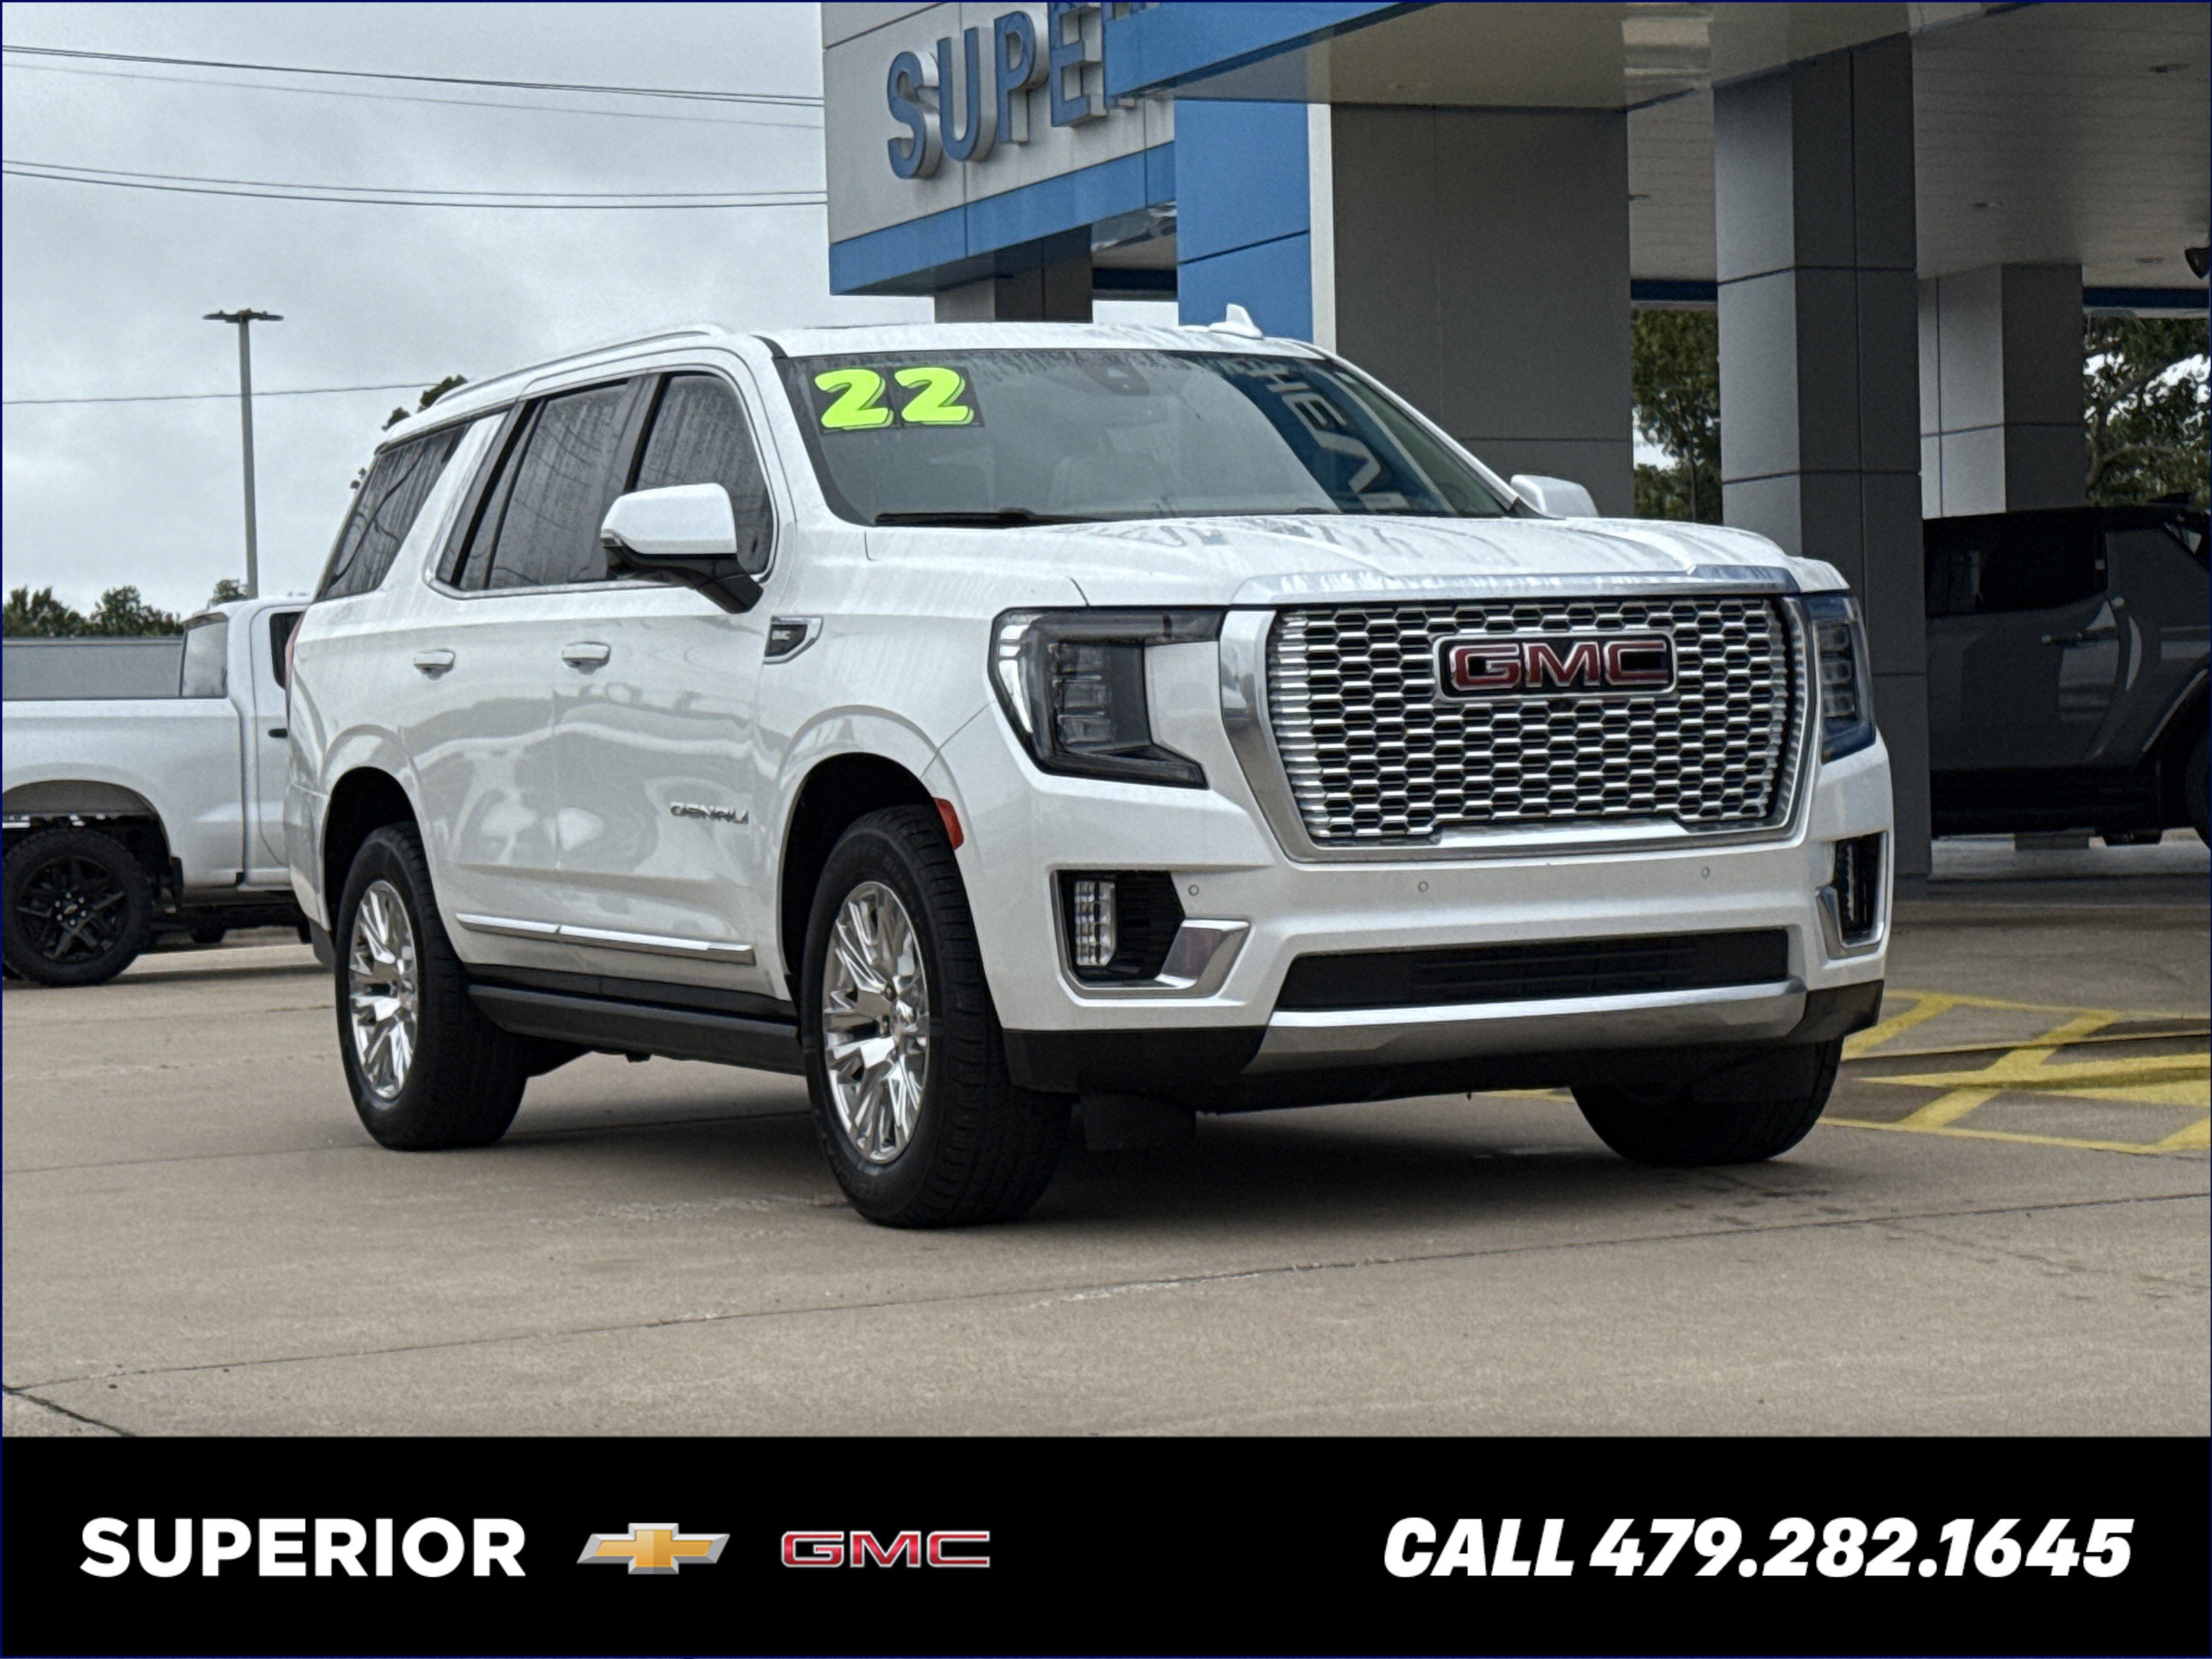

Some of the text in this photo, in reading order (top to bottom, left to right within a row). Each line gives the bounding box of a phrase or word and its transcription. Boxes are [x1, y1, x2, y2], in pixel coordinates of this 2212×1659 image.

[887, 2, 1147, 180] SUPE
[815, 366, 974, 430] 22
[1448, 639, 1669, 691] GMC
